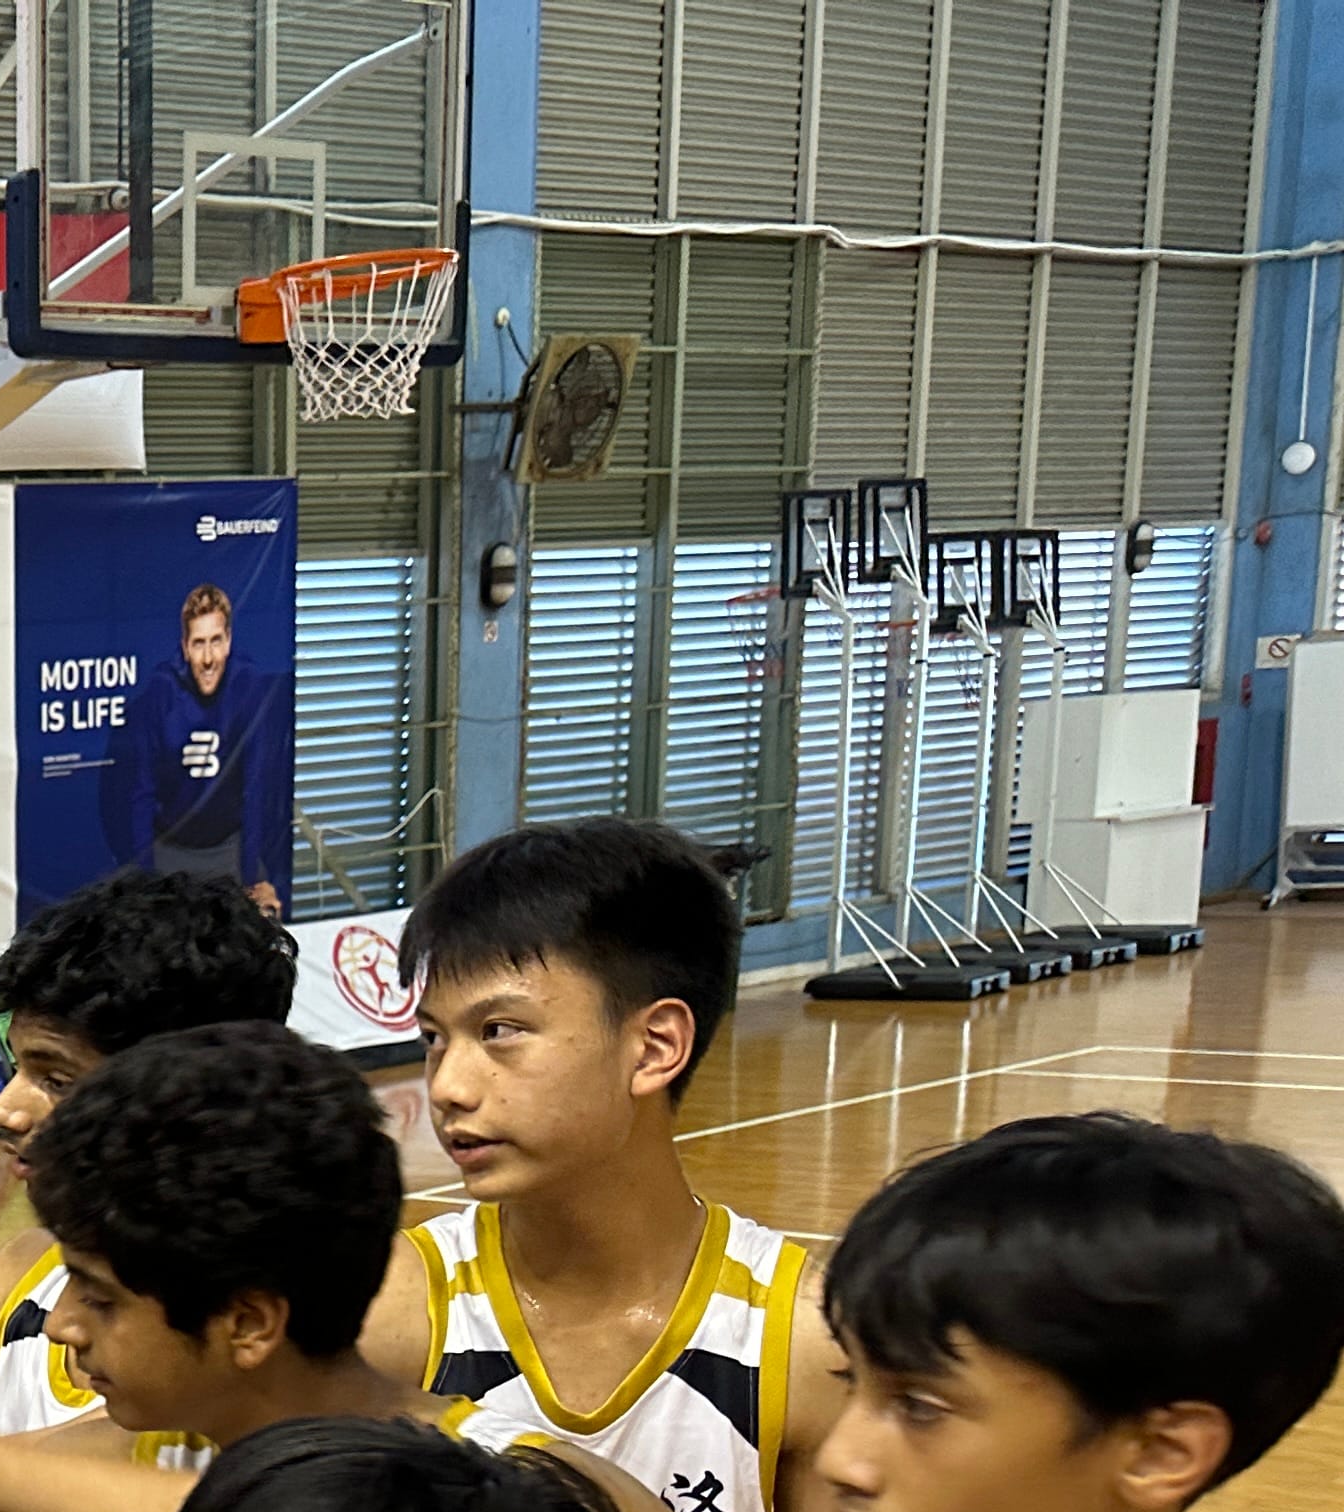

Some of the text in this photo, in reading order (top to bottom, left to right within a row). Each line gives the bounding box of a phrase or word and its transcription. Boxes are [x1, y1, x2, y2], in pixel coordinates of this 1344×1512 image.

[41, 655, 137, 693] MOTION
[41, 696, 126, 733] IS LIFE
